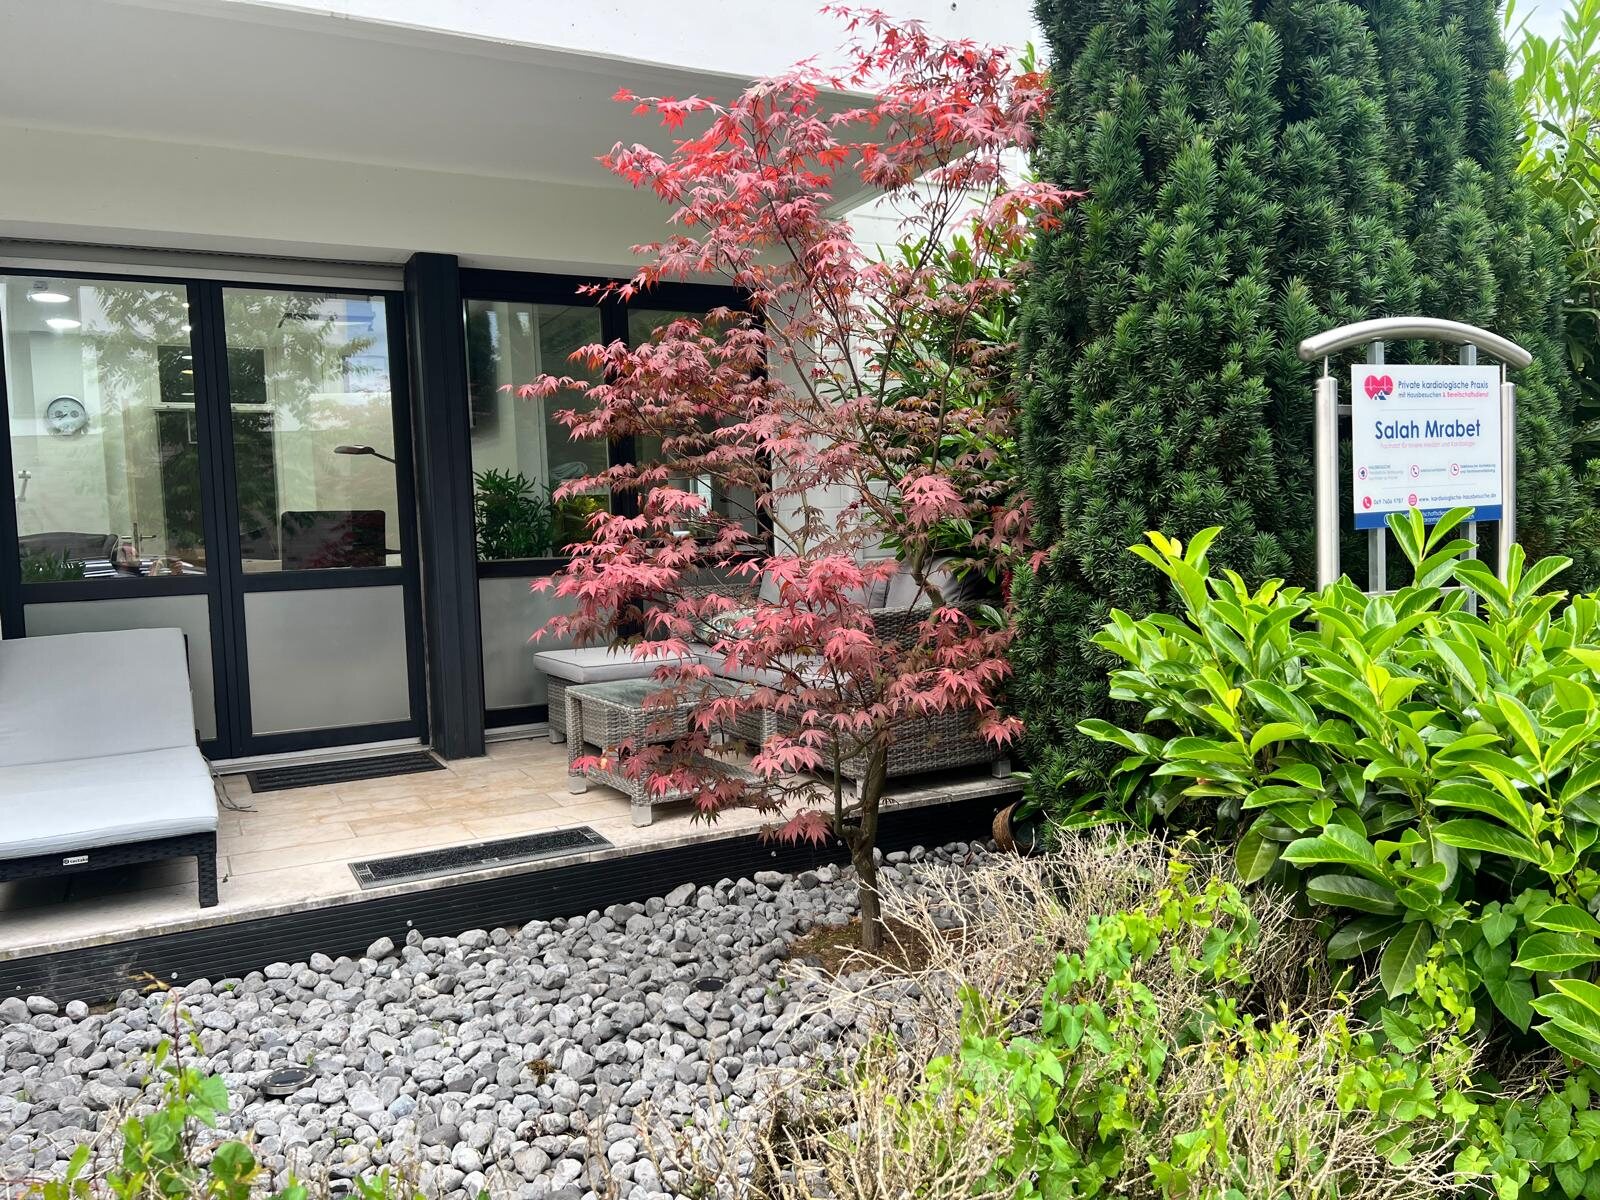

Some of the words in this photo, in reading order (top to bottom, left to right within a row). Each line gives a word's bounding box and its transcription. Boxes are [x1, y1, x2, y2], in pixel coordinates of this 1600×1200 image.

[1398, 381, 1420, 389] Private
[1421, 380, 1469, 391] kardiologische
[1470, 380, 1489, 389] Praxis
[1375, 420, 1420, 440] Salah
[1425, 419, 1481, 438] Mrabet
